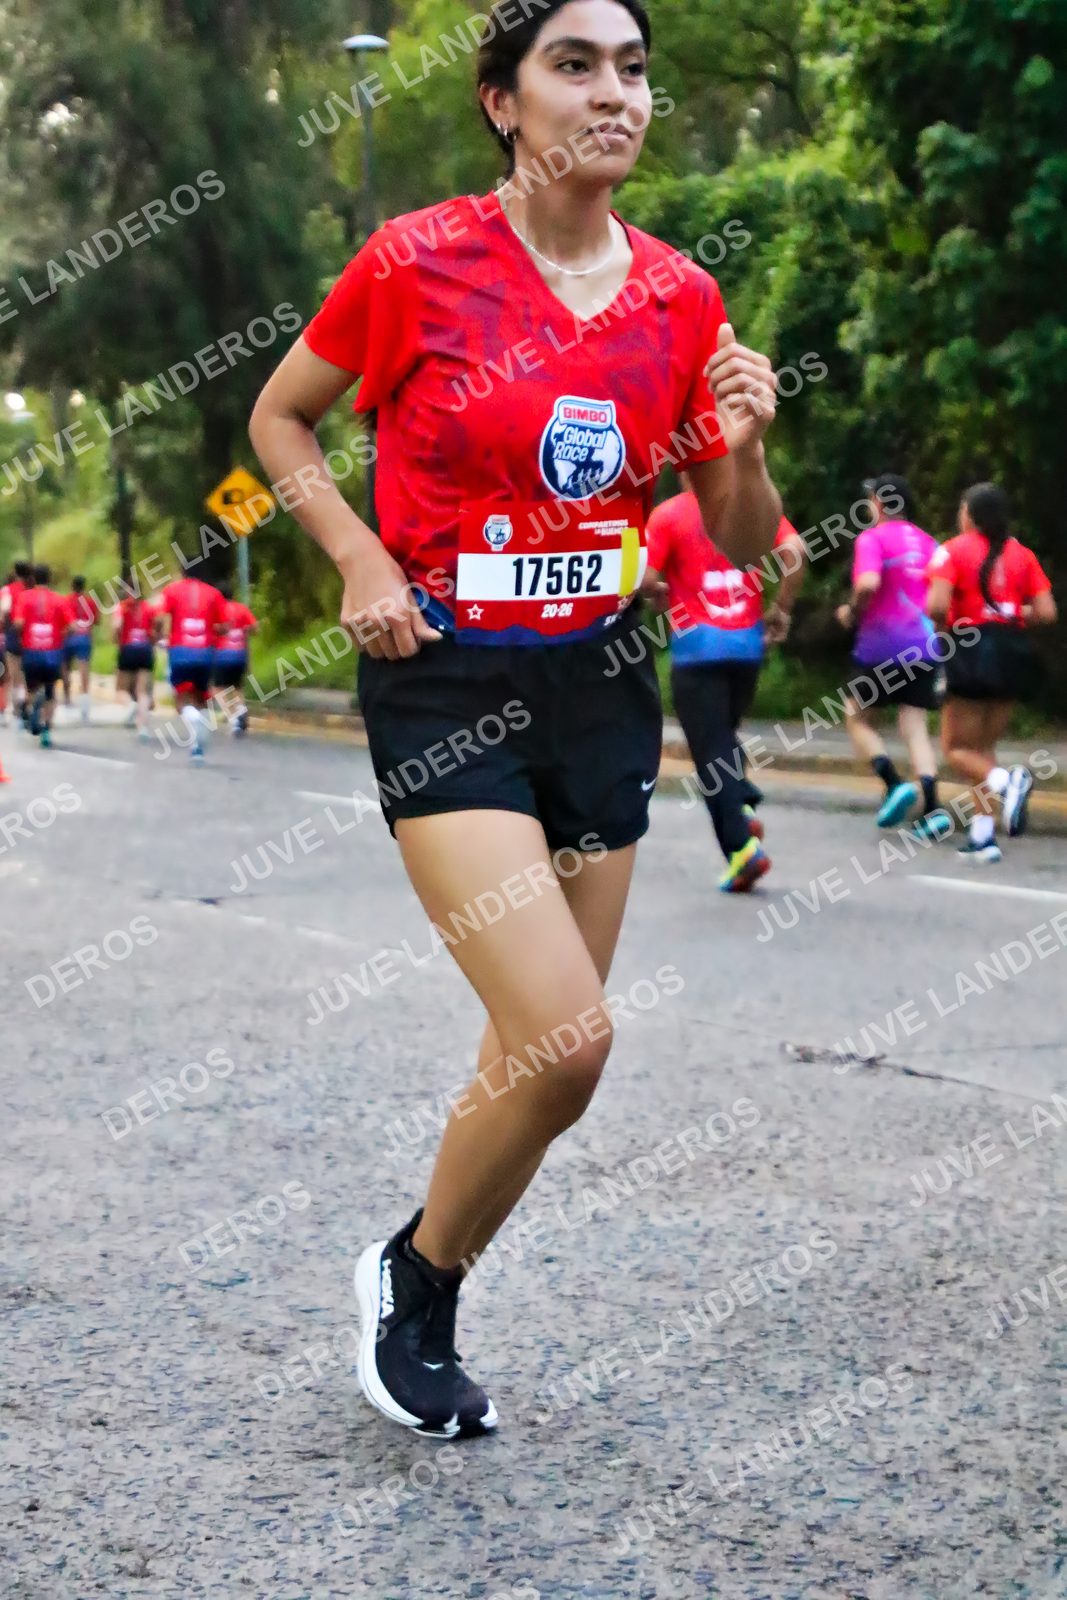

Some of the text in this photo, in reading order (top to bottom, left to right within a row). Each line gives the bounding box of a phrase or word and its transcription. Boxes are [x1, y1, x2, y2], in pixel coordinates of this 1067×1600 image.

[563, 407, 607, 423] BIMBO
[563, 427, 606, 449] Global
[553, 441, 589, 462] Race
[513, 554, 602, 596] 17562
[541, 602, 574, 618] 20-26
